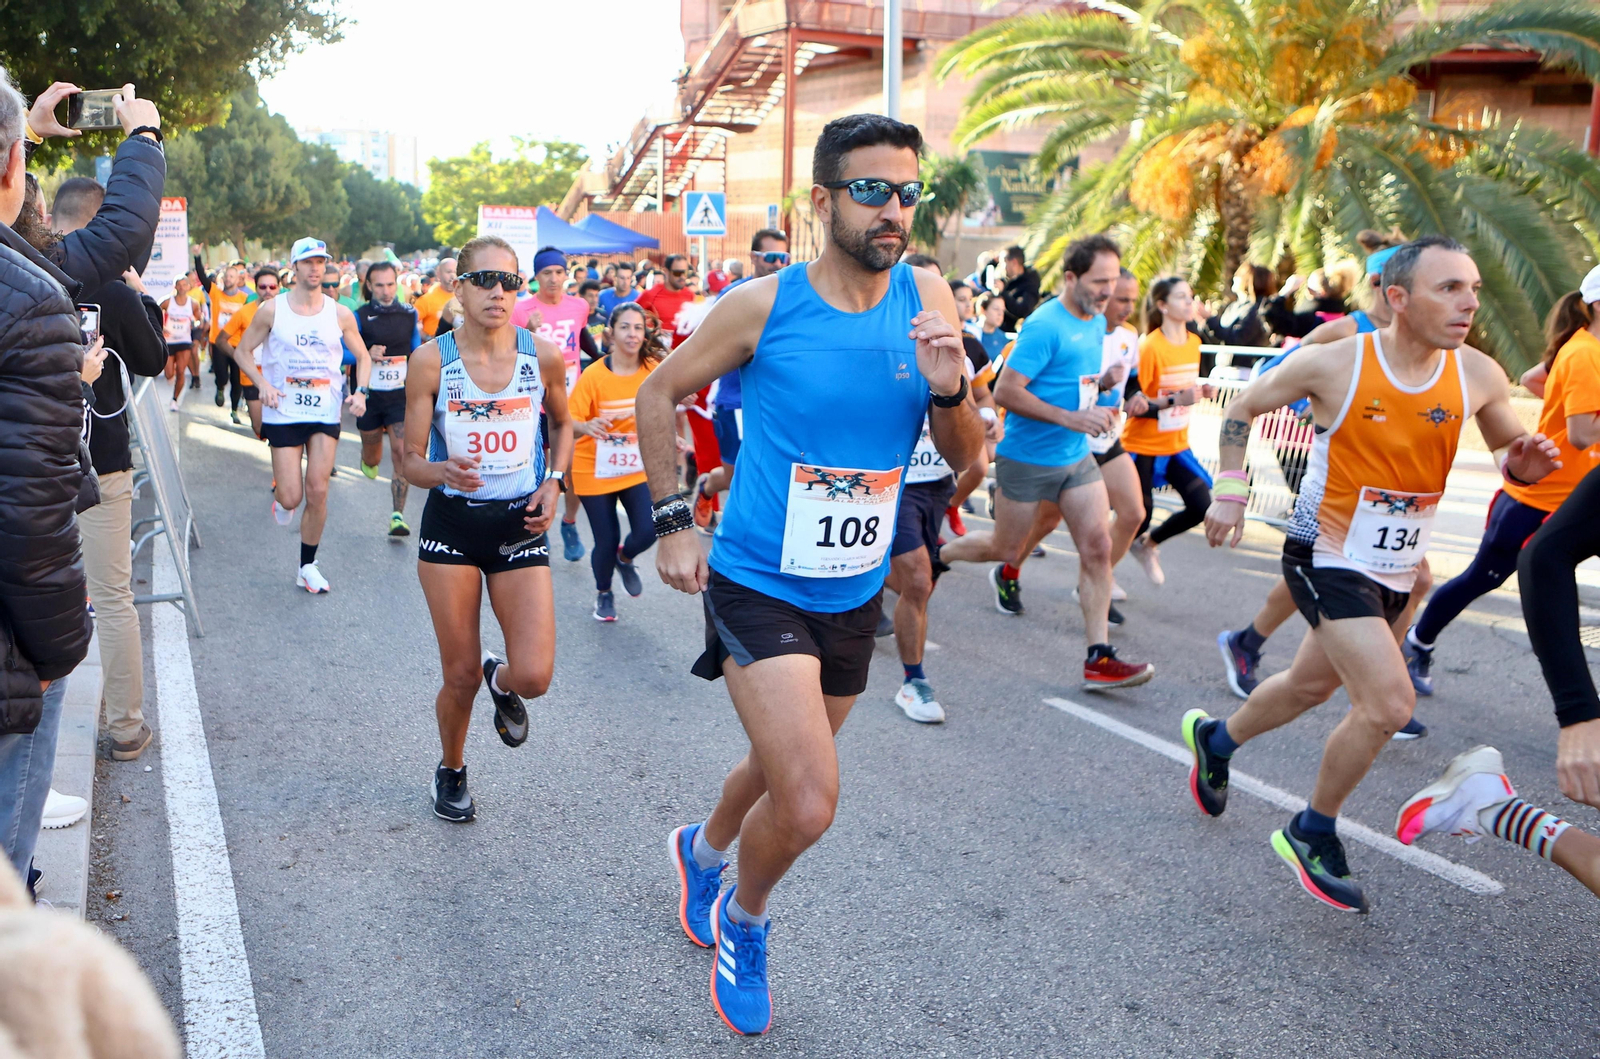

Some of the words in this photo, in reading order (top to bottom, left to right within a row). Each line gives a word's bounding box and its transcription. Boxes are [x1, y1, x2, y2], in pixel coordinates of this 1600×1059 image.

[483, 207, 535, 219] SALIDA
[378, 370, 400, 381] 563
[294, 392, 322, 408] 382
[467, 430, 518, 454] 300
[608, 452, 638, 467] 432
[816, 515, 881, 549] 108
[1372, 526, 1422, 551] 134
